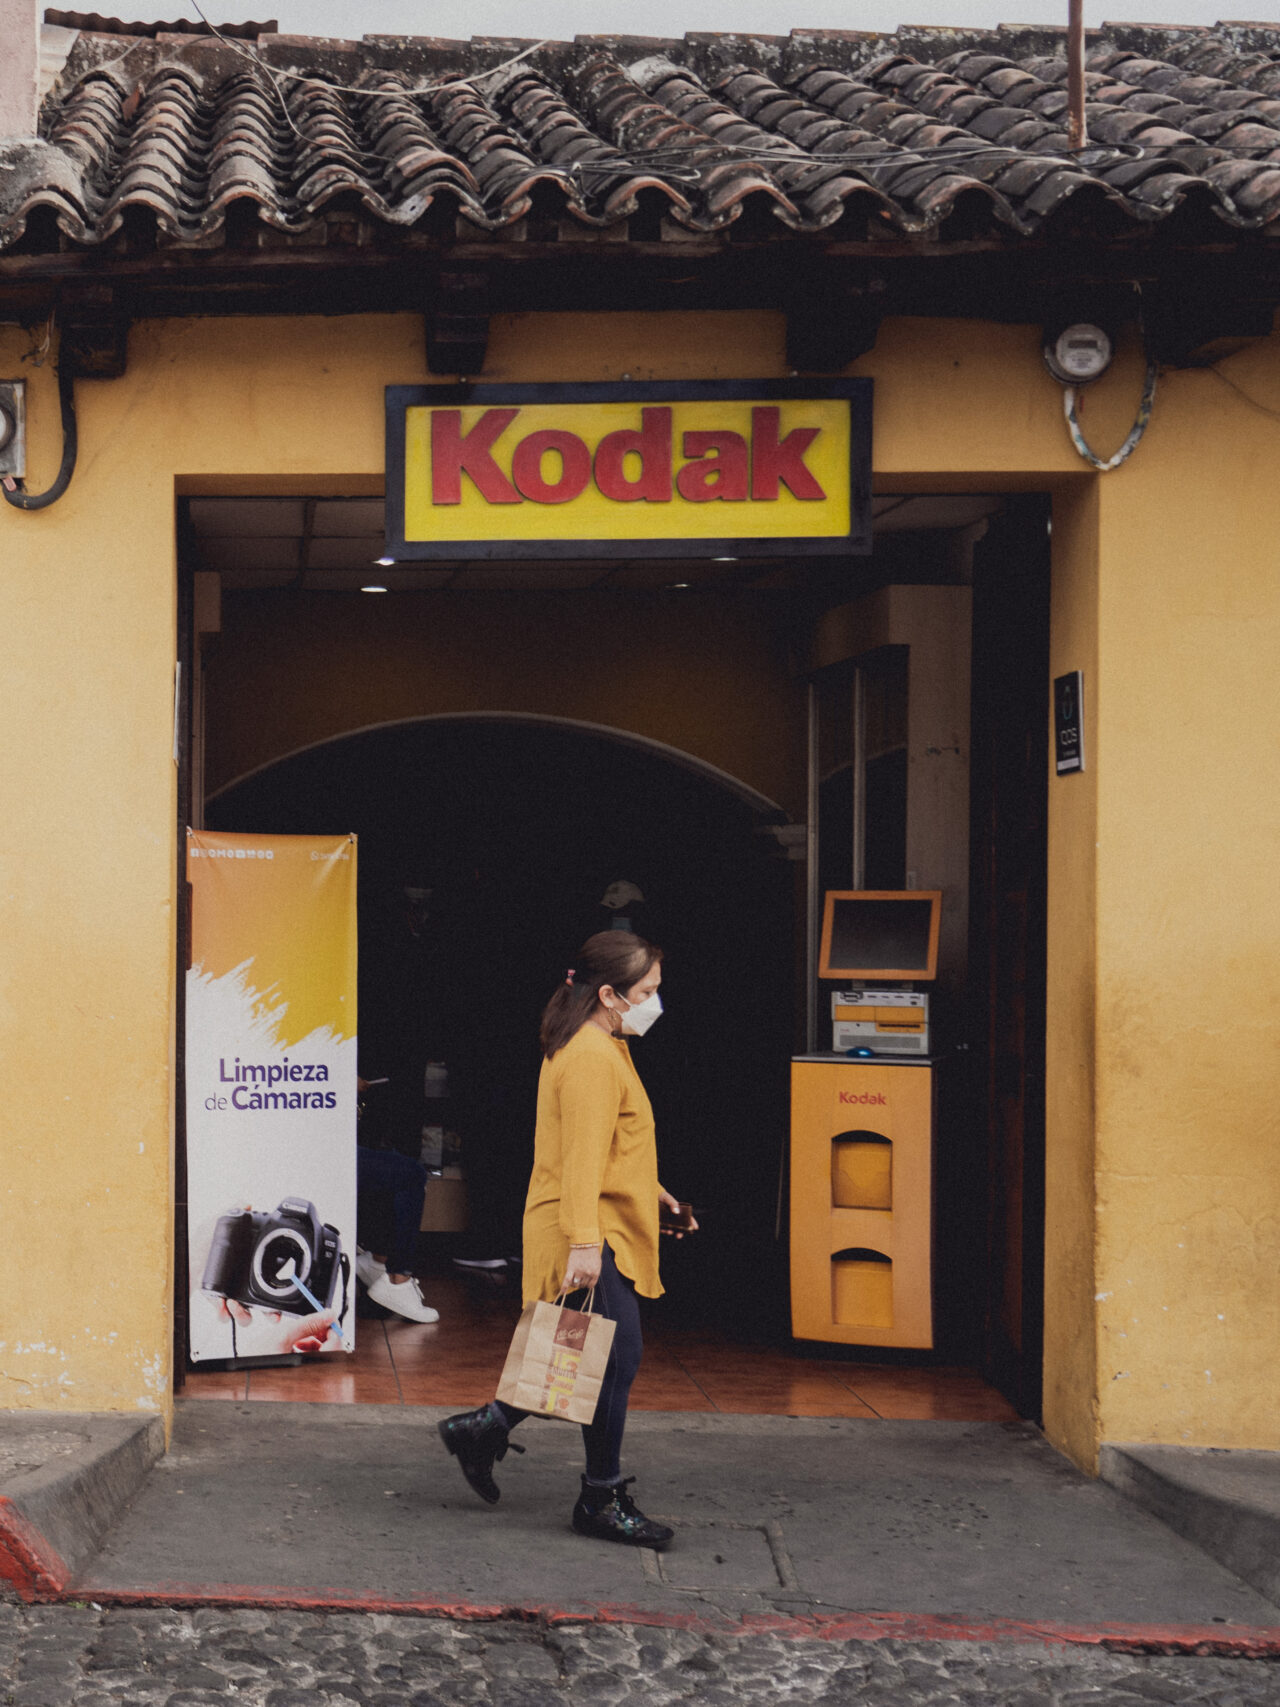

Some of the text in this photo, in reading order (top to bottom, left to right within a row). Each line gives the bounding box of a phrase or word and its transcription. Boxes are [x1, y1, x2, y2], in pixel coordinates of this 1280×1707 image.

[430, 405, 828, 505] Kodak
[219, 1057, 329, 1087] Limpieza
[204, 1084, 337, 1111] de Cámaras
[839, 1091, 887, 1105] Kodak
